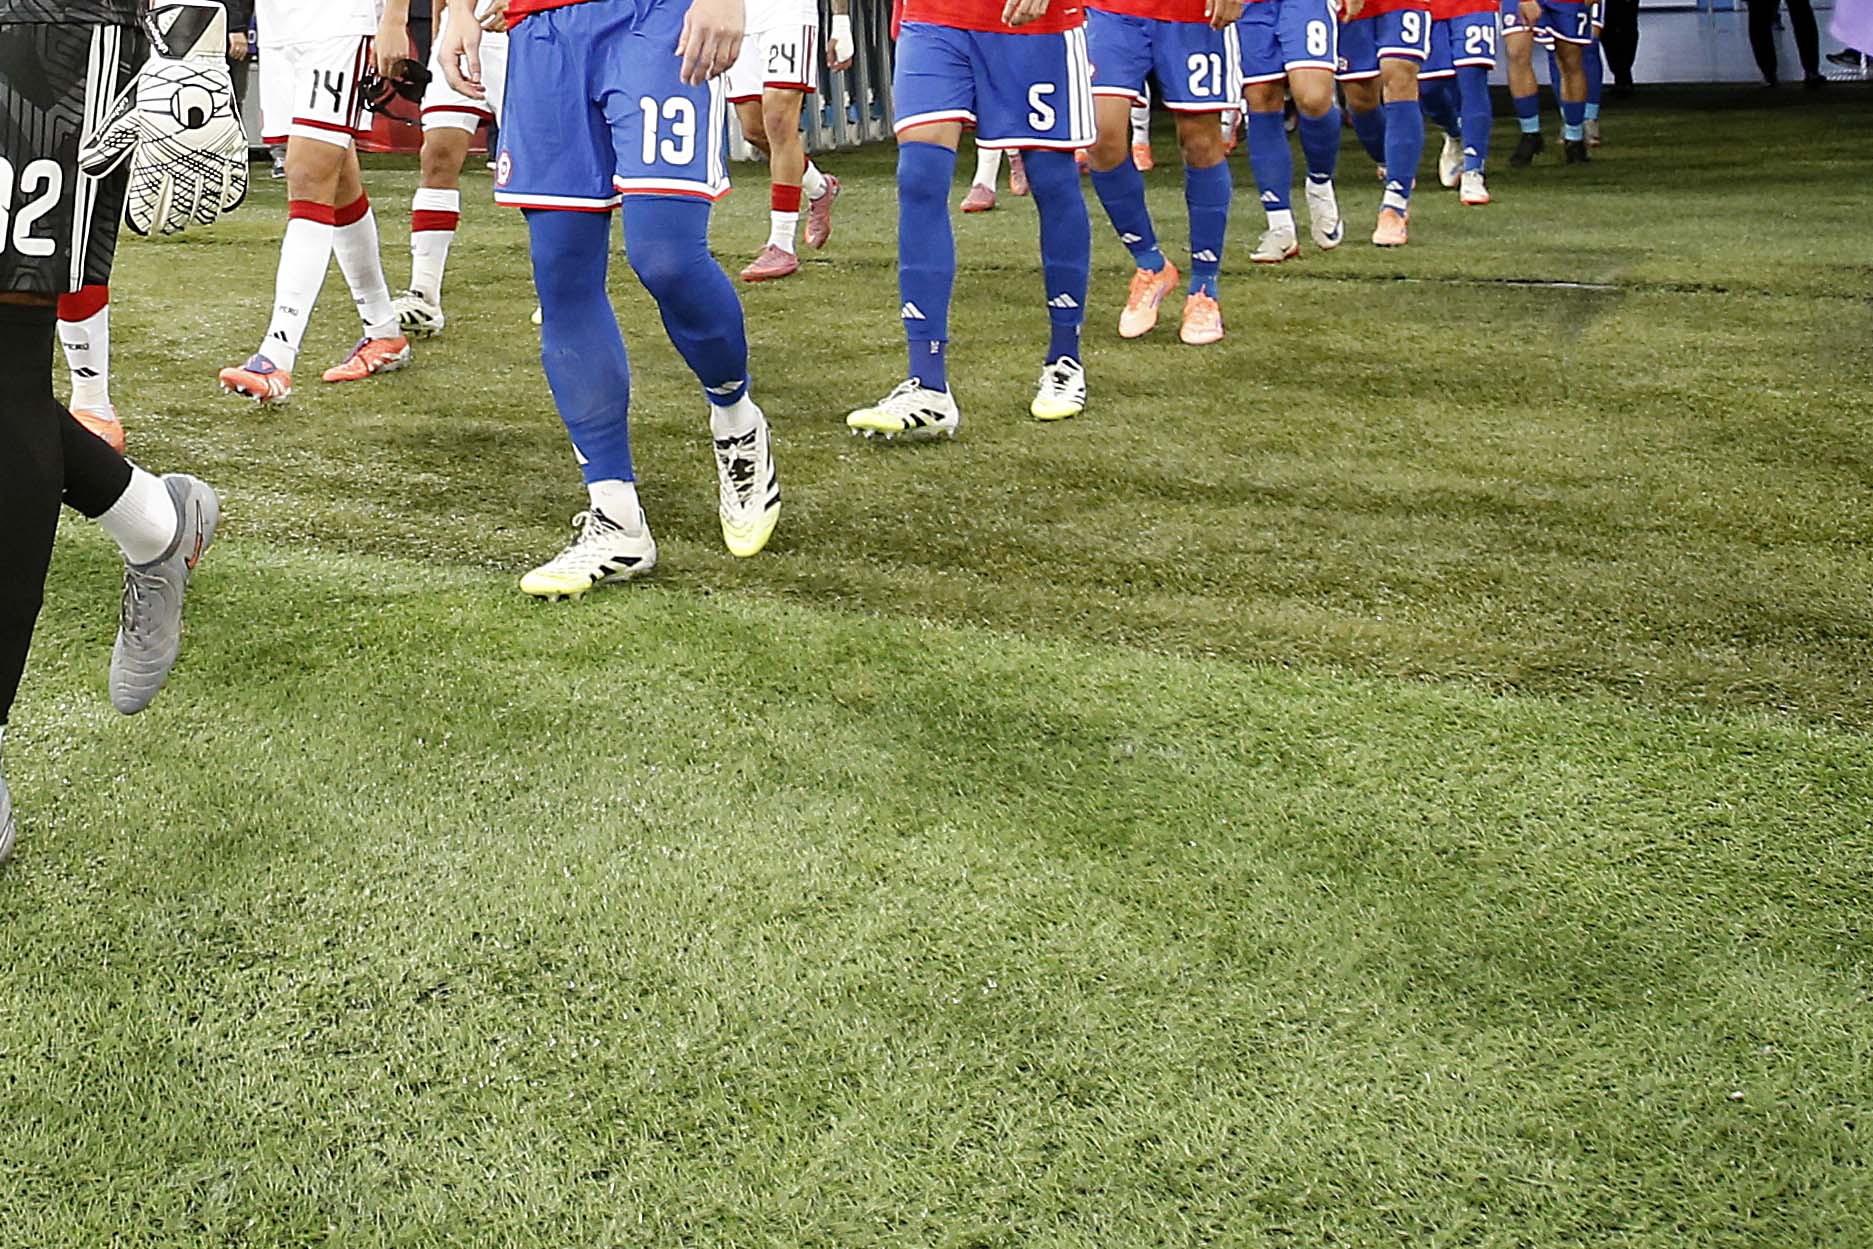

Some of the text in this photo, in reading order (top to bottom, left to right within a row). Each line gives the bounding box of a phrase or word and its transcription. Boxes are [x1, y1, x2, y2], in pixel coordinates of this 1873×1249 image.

[1306, 19, 1328, 56] 8
[1401, 11, 1421, 43] 9
[1465, 25, 1495, 55] 24
[1577, 12, 1588, 36] 7
[767, 43, 796, 73] 24
[1187, 53, 1224, 97] 21
[309, 69, 345, 113] 14
[1028, 83, 1056, 131] 5
[639, 96, 696, 165] 13
